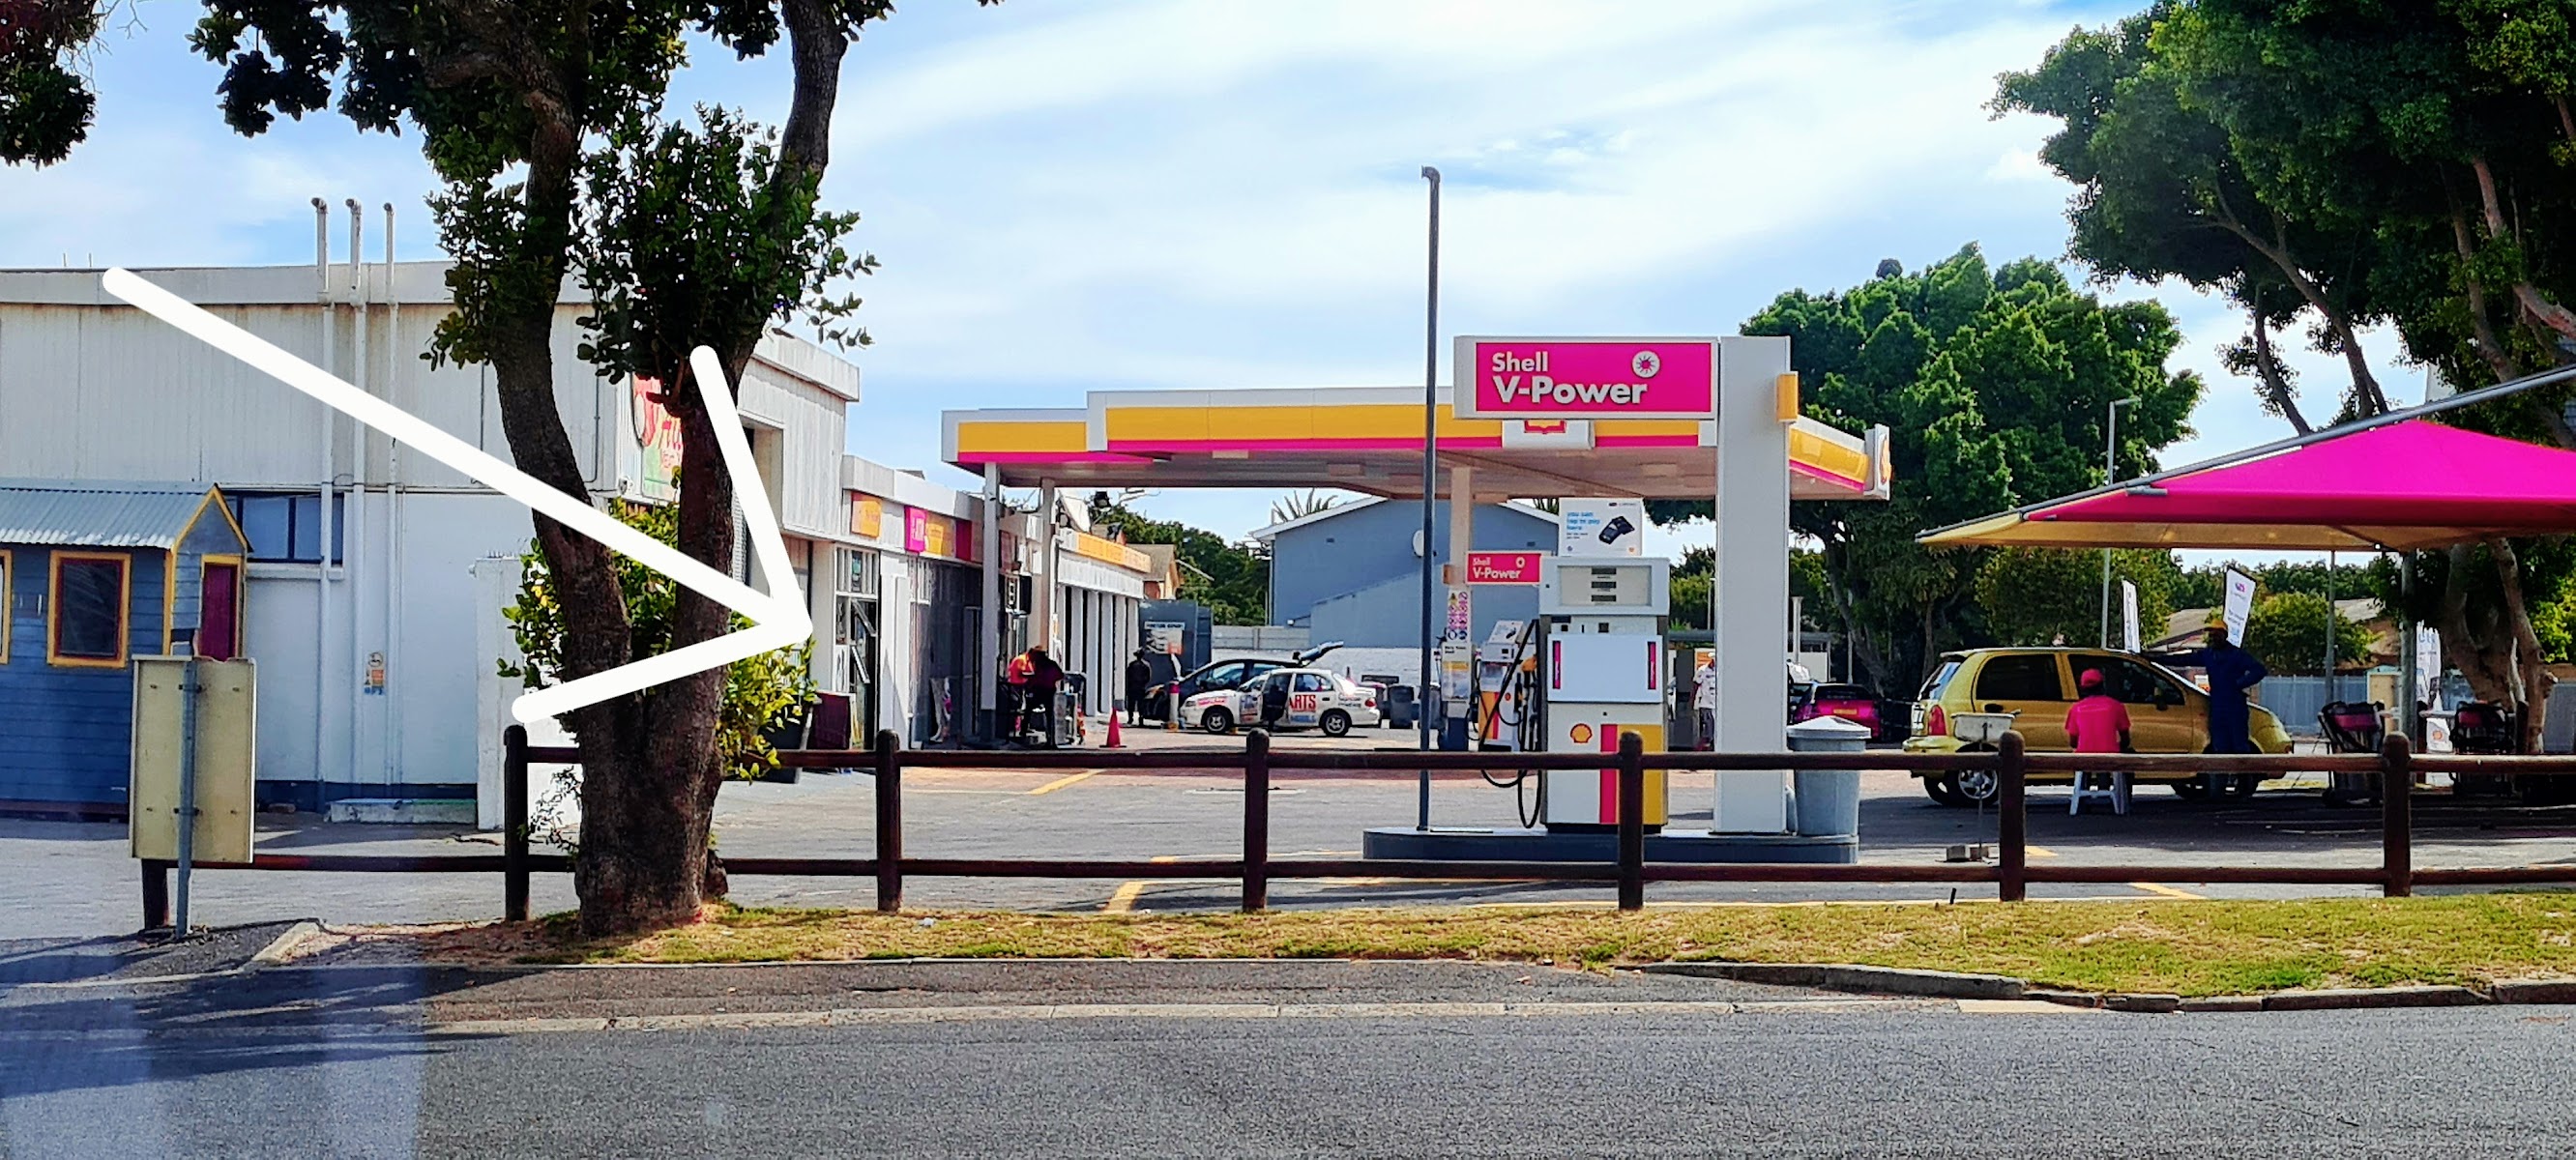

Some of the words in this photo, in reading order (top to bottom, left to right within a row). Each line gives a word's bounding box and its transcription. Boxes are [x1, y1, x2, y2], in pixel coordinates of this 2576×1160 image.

[1492, 351, 1548, 372] Shell
[1492, 375, 1648, 404] V-Power
[1473, 557, 1491, 566] Shell
[1473, 566, 1521, 579] V-Power
